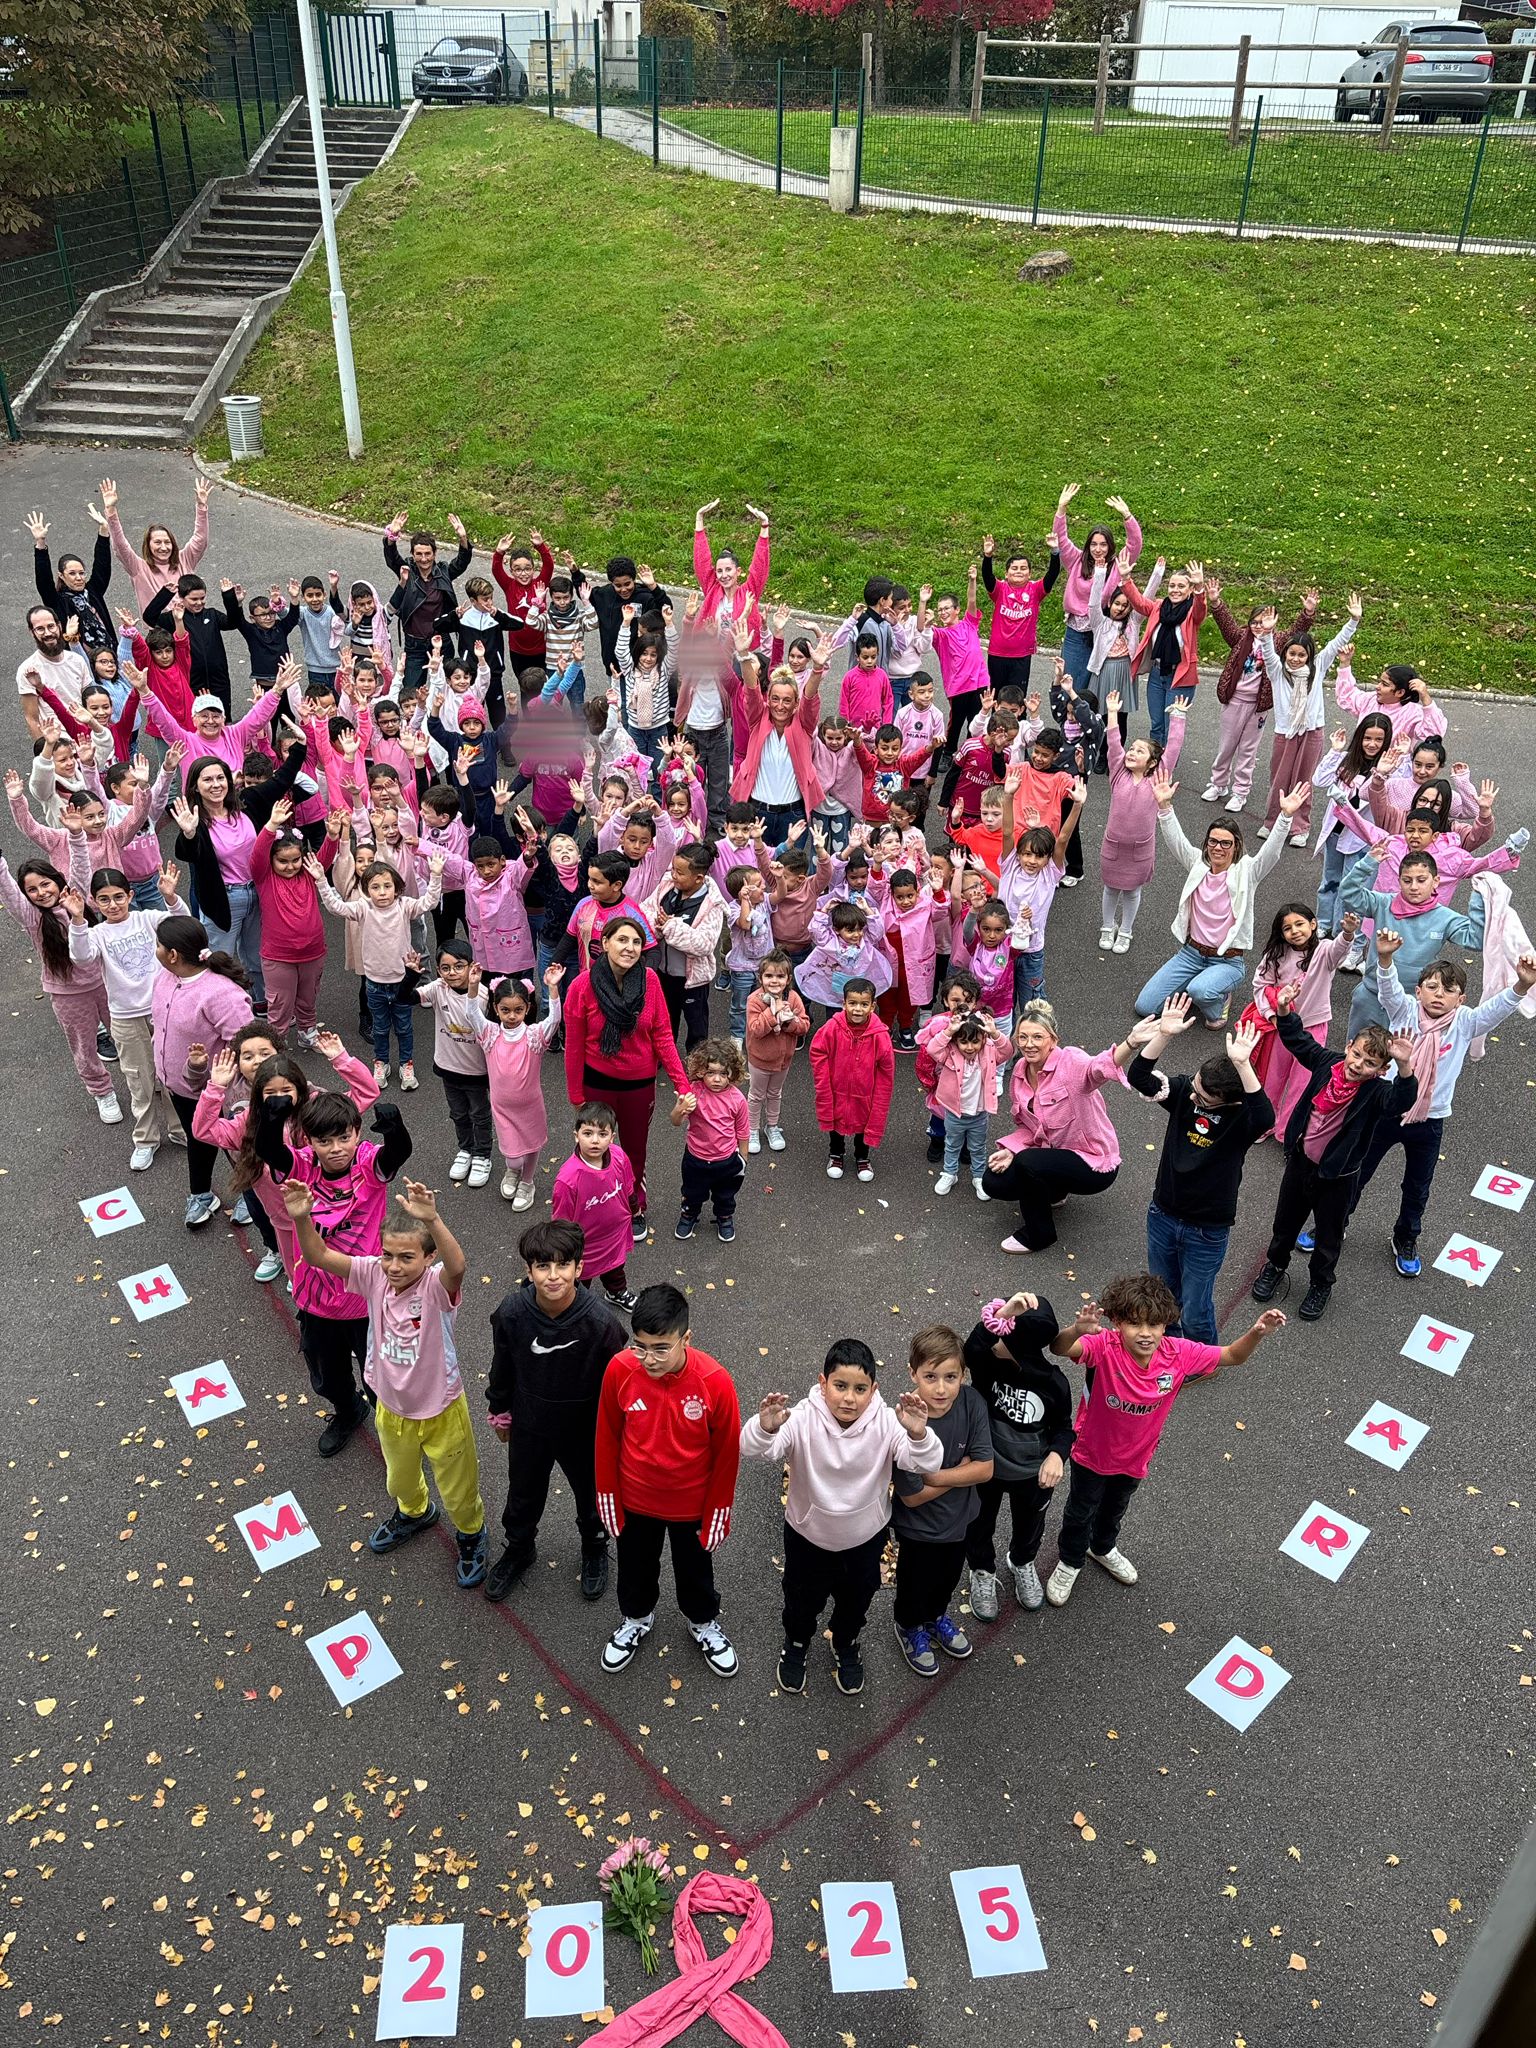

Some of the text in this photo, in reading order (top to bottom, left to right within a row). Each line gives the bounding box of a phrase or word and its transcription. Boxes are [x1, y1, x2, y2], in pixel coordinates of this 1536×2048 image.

[906, 732, 928, 740] MIAMI
[965, 771, 994, 786] Emirate
[978, 770, 990, 780] Fly
[1488, 1175, 1521, 1195] B
[96, 1199, 127, 1220] C
[1448, 1247, 1486, 1271] A
[134, 1276, 173, 1305] H
[1427, 1326, 1458, 1352] T
[186, 1377, 227, 1408] A
[991, 1380, 1025, 1411] NORTH
[1003, 1383, 1026, 1401] THE
[994, 1398, 1024, 1423] FACE
[1364, 1419, 1408, 1451] A
[246, 1504, 304, 1551] M
[1300, 1514, 1351, 1557] R
[326, 1634, 372, 1680] P
[1215, 1654, 1266, 1699] D
[848, 1901, 891, 1957] 2
[979, 1887, 1020, 1942] 5
[546, 1924, 592, 1977] 0
[403, 1946, 446, 2003] 2
